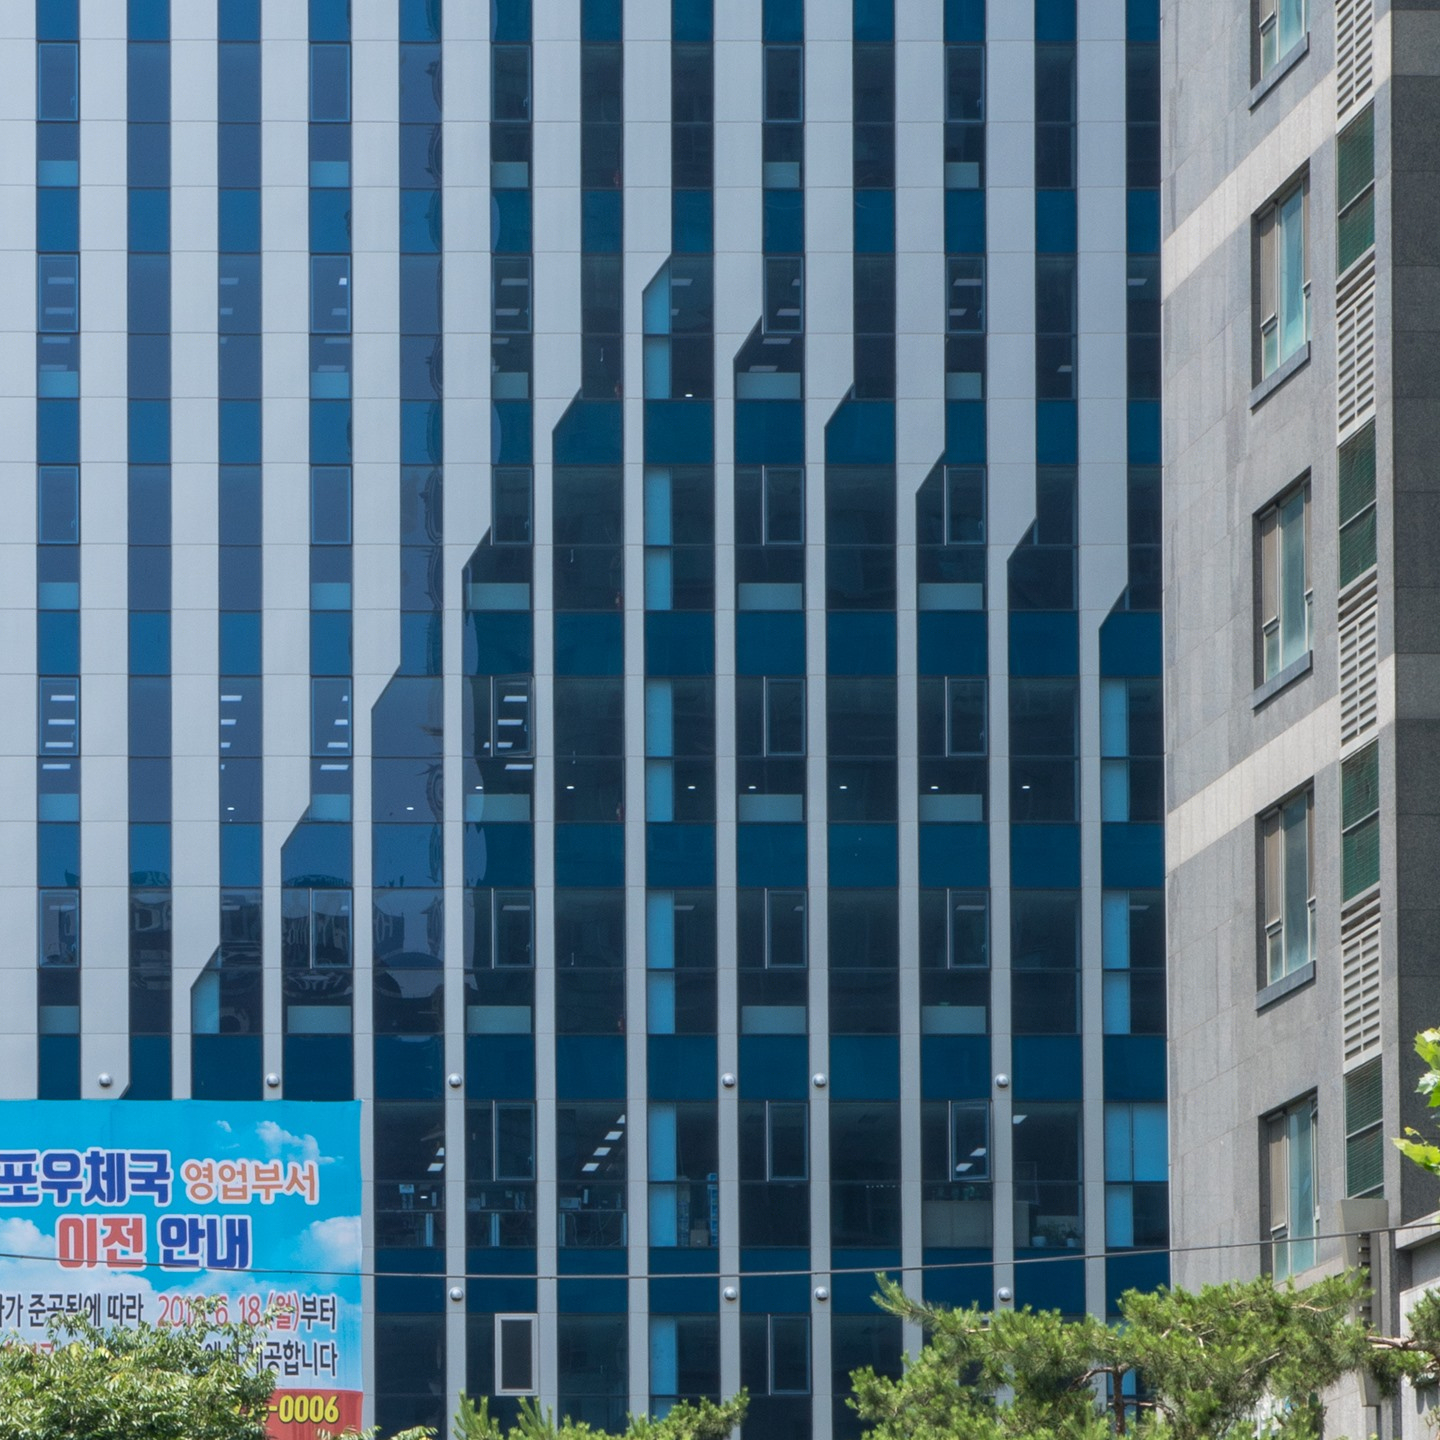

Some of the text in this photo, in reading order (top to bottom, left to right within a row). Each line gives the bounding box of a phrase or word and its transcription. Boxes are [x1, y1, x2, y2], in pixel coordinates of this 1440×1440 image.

[184, 1162, 316, 1202] 영업부서
[59, 1218, 249, 1269] 이전 안내
[107, 1293, 144, 1327] 따라
